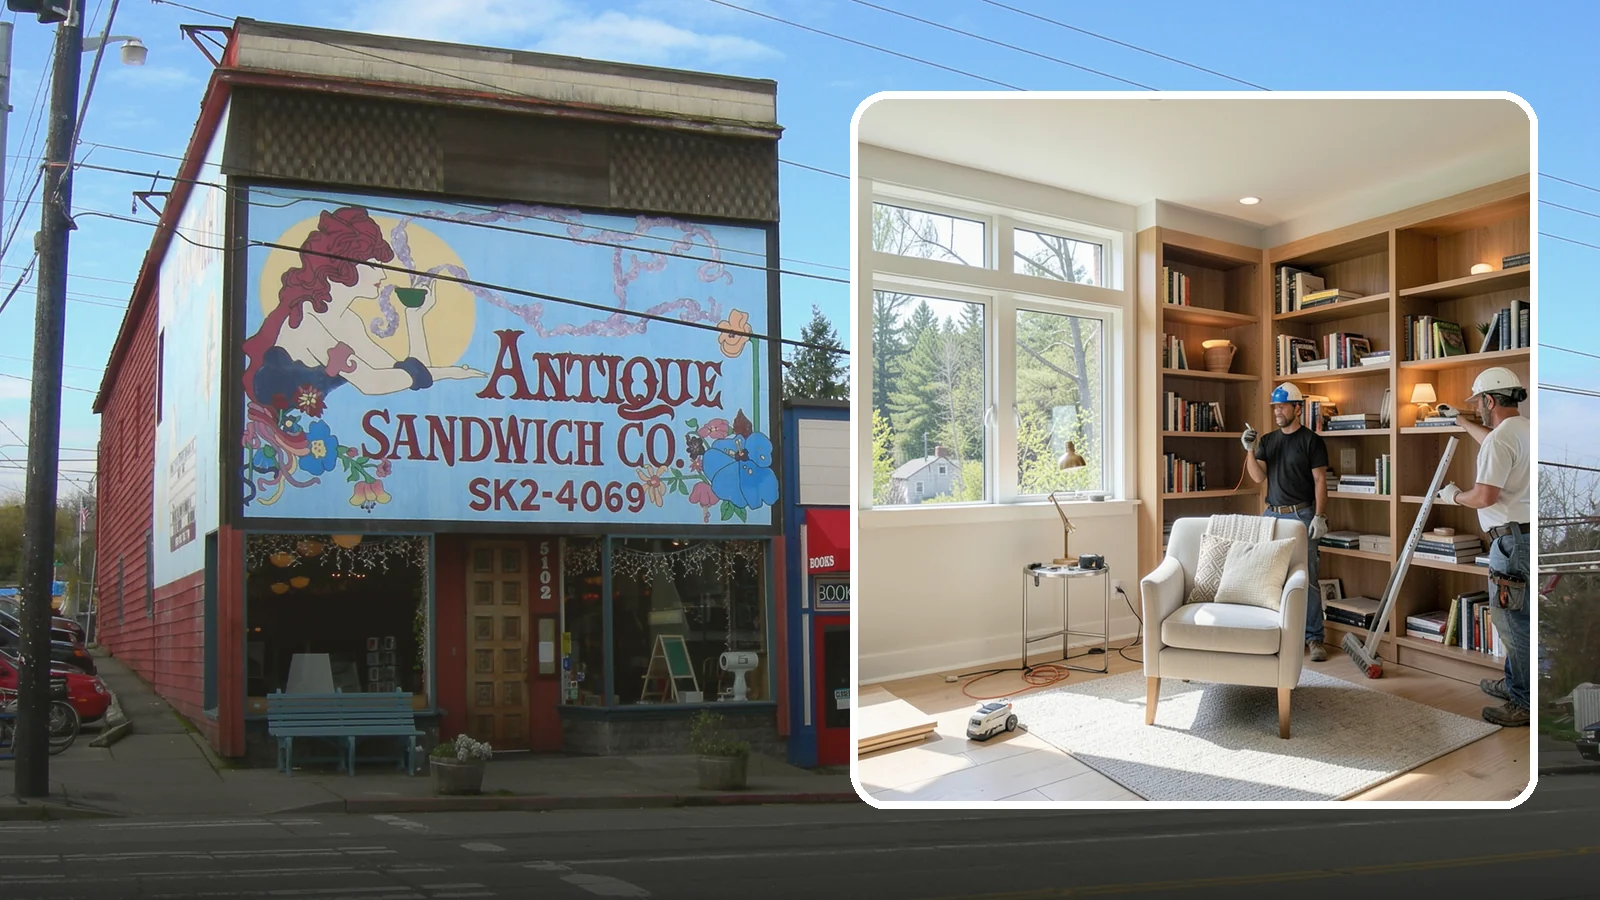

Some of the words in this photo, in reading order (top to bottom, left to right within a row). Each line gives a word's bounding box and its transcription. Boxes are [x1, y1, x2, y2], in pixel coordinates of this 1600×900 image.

[476, 329, 722, 420] ANTIQUE
[361, 409, 604, 466] SANDWICH
[617, 422, 684, 469] CO.
[468, 477, 645, 513] SK2-4069
[539, 541, 552, 600] 5102
[809, 555, 835, 569] BOOKS
